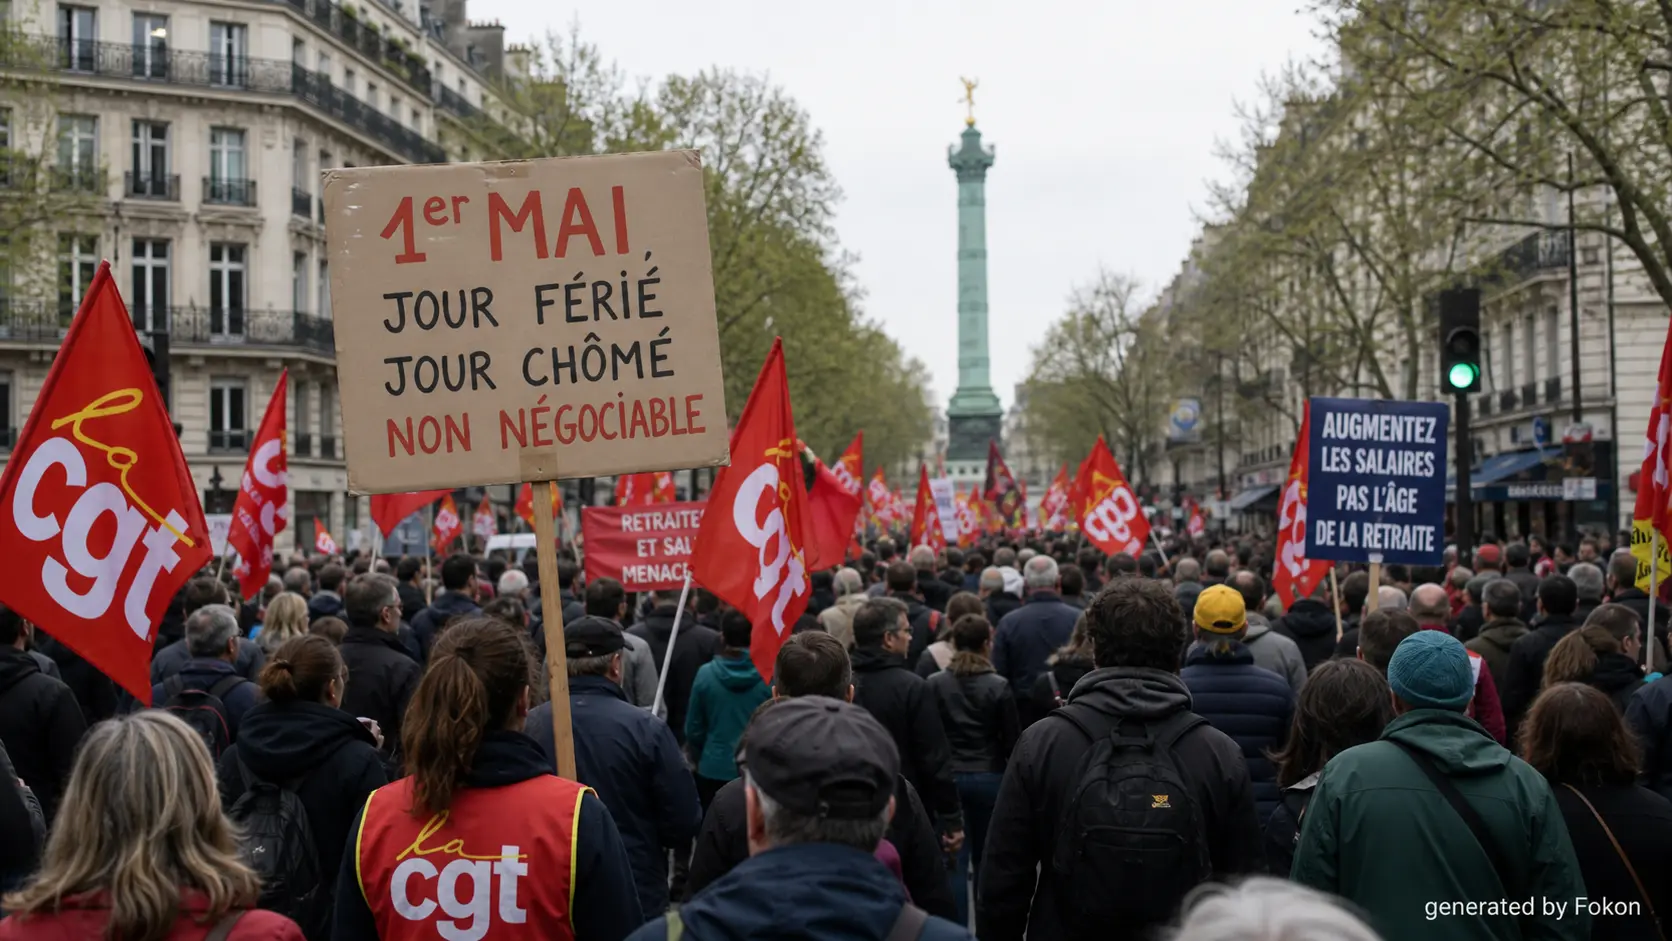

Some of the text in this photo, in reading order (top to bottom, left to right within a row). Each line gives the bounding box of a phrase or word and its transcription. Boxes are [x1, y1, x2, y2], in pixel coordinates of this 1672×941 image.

[379, 185, 630, 264] 1er MAI
[382, 286, 499, 334] JOUR
[383, 326, 675, 397] JOUR CHÔMÉ
[387, 412, 471, 458] NON
[1321, 411, 1437, 444] AUGMENTEZ
[1321, 446, 1435, 477] LES SALAIRES
[1337, 481, 1418, 514] PAS L'ÂGE
[13, 437, 190, 641] cgt
[636, 535, 693, 558] ET SAL
[1315, 520, 1435, 552] DE LA RETRAITE
[396, 812, 527, 861] la
[390, 845, 528, 941] cgt
